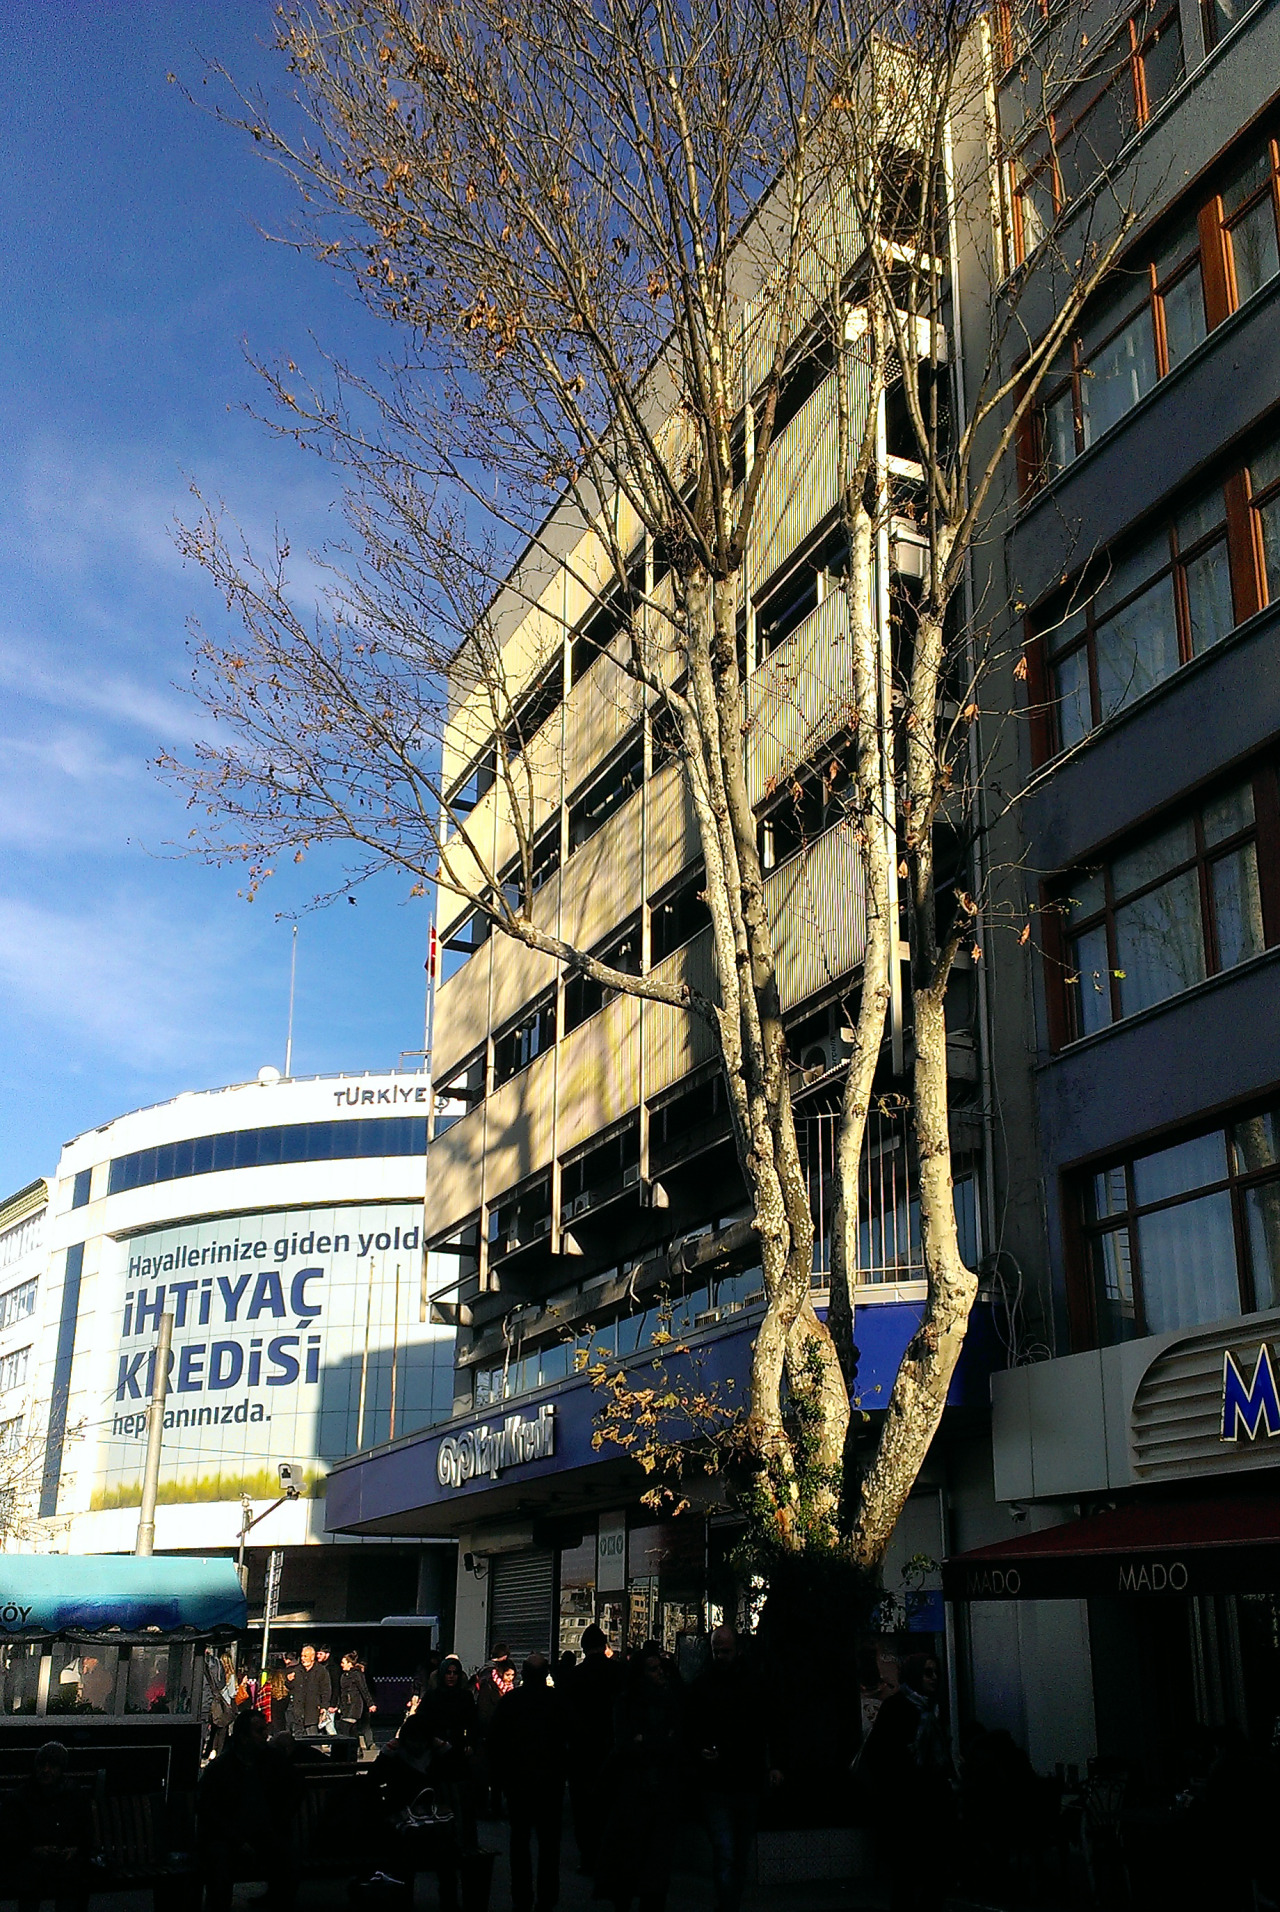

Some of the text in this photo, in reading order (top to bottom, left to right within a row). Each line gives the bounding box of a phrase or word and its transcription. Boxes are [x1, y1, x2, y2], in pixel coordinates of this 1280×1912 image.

[334, 1084, 427, 1106] TÜRKİYE
[128, 1238, 267, 1279] Hayallerinize
[274, 1231, 350, 1262] giden
[112, 1399, 272, 1438] hep anınızda.
[966, 1568, 1022, 1595] MADO
[1118, 1562, 1189, 1592] MADO
